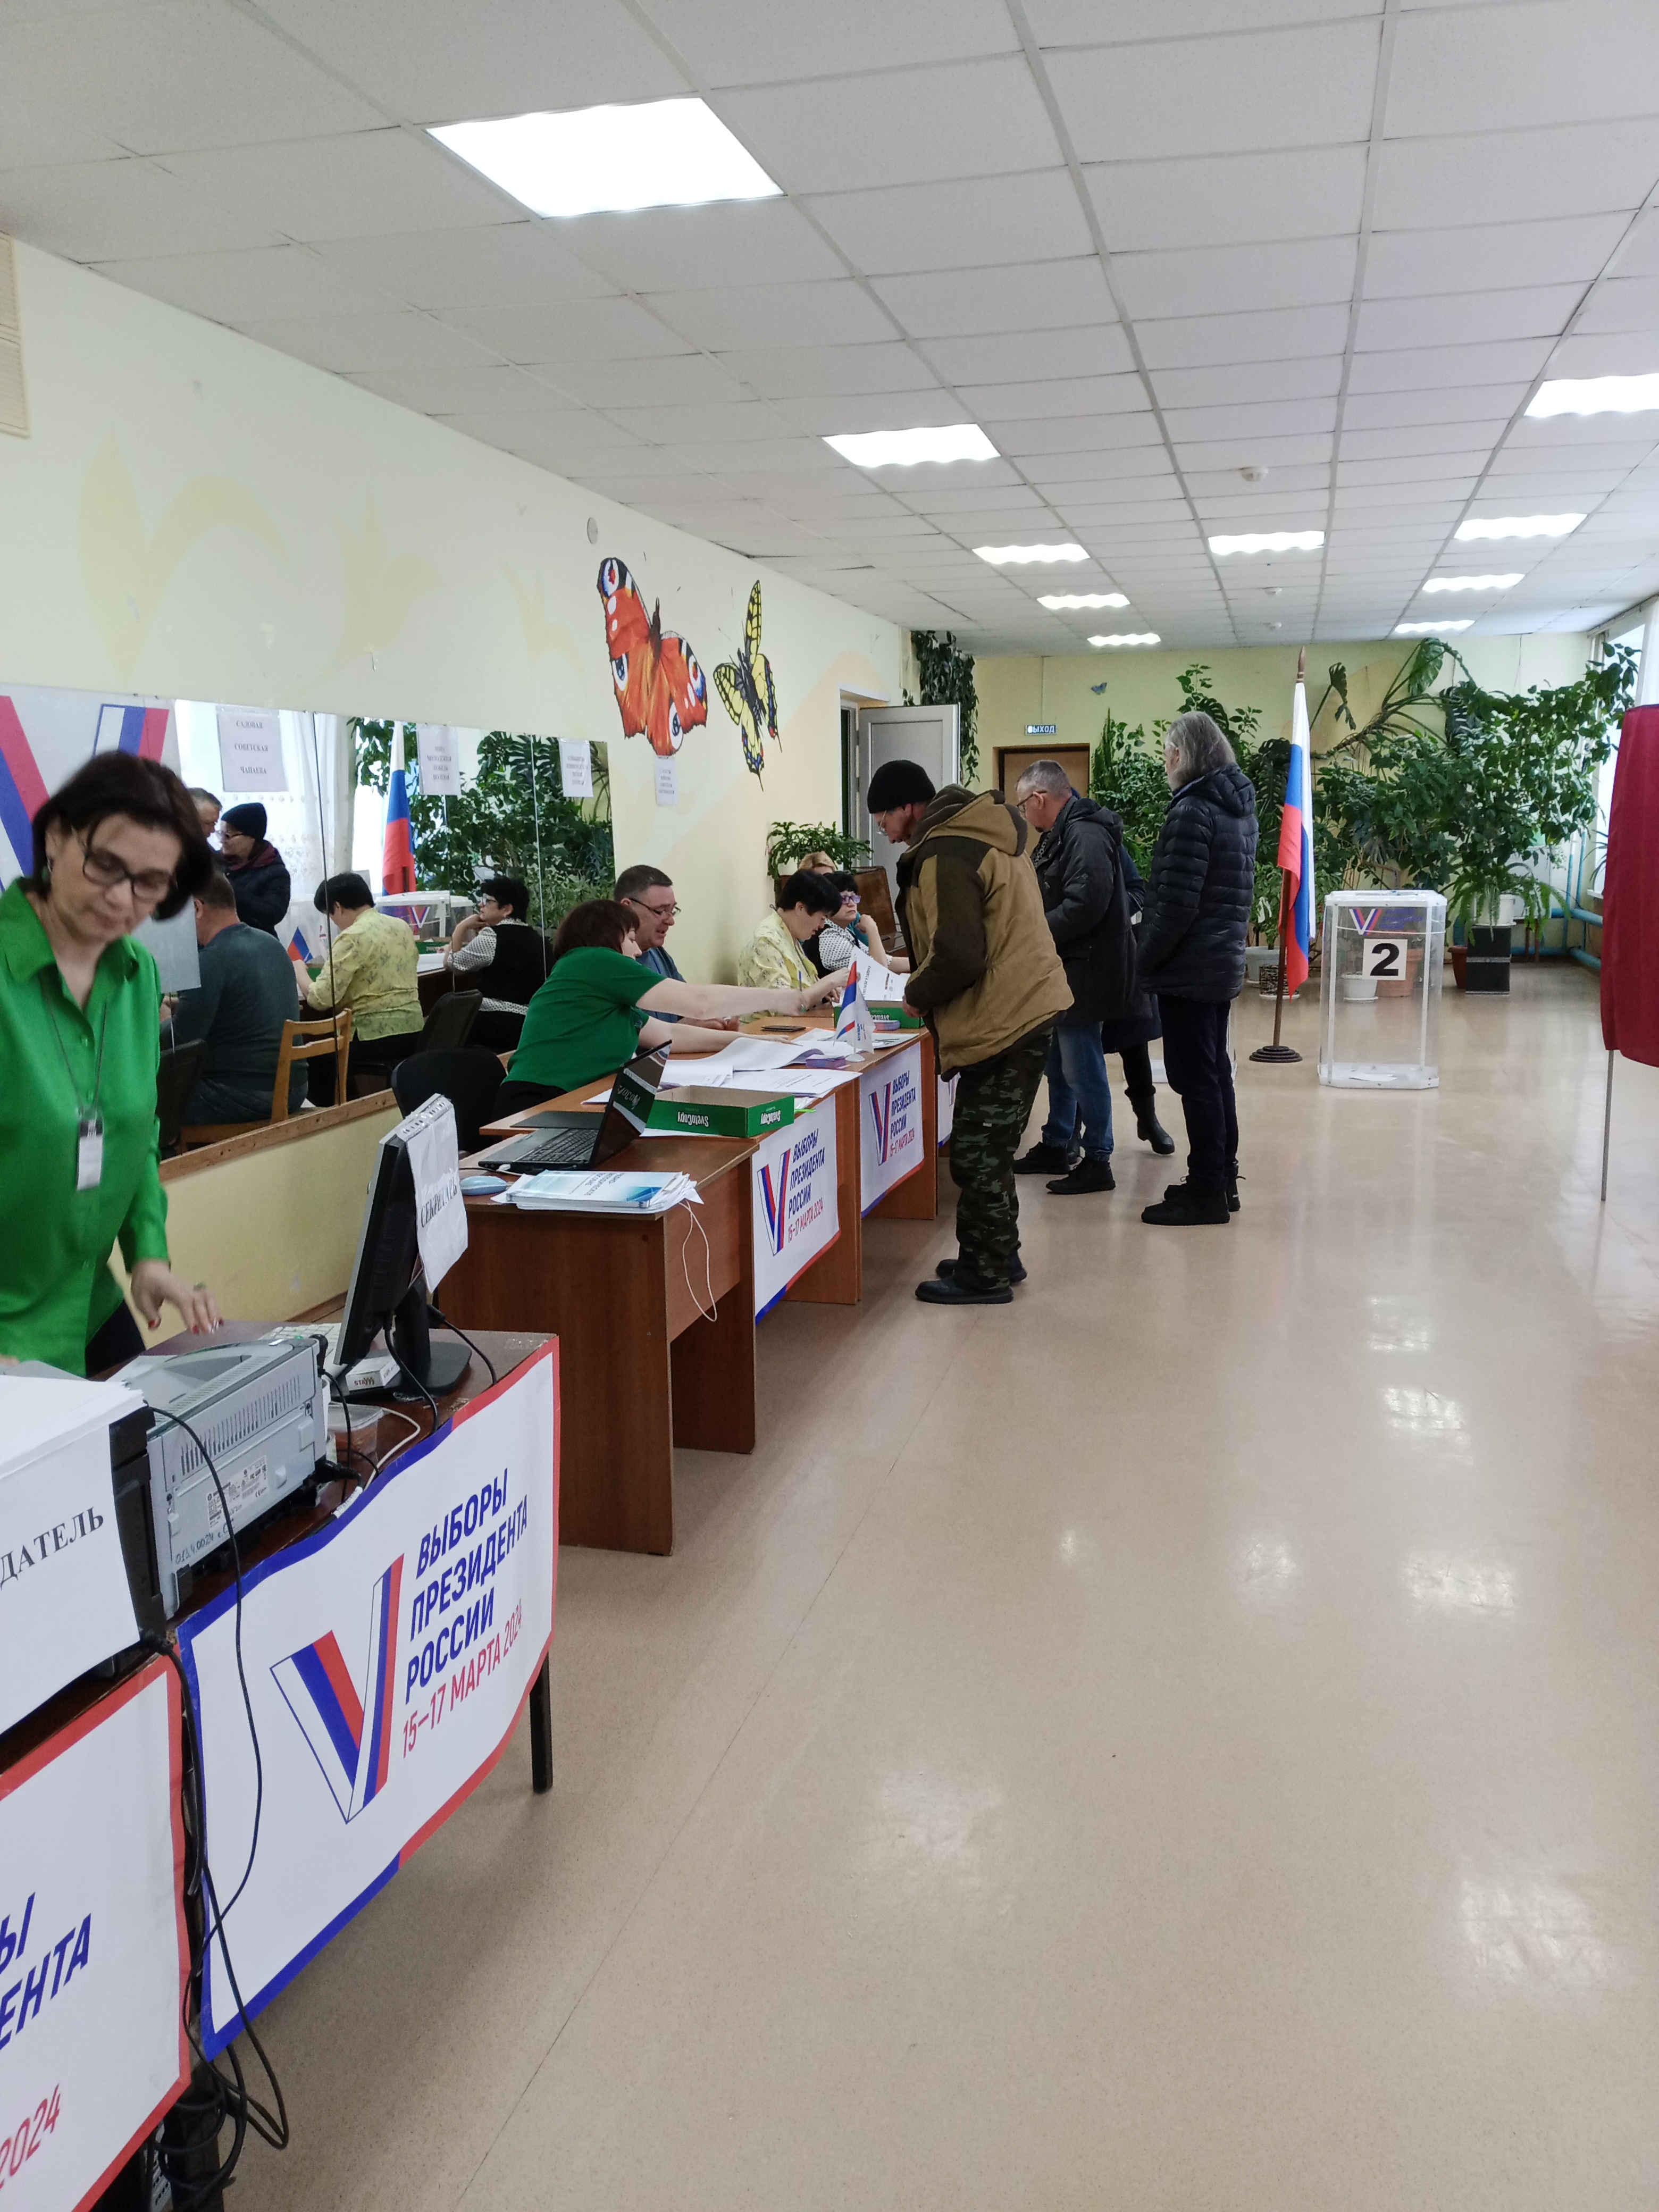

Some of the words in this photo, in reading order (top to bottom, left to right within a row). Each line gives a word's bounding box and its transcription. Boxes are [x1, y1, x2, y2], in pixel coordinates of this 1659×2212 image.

[1370, 943, 1400, 976] 2
[892, 1070, 910, 1095] ВЫБОРЫ
[677, 1111, 709, 1127] SvetoCopy
[760, 1110, 781, 1125] SvetoCopy
[891, 1087, 916, 1117] ПРЕЗИДЕНТА
[890, 1113, 907, 1139] РОССИИ
[792, 1128, 819, 1163] ВЫБОРЫ
[790, 1147, 825, 1191] ПРЕЗИДЕНТА
[789, 1182, 811, 1219] РОССИИ
[800, 1205, 813, 1232] МАРТА
[814, 1197, 824, 1219] 2024
[416, 1467, 508, 1580] ВЫБОРЫ
[0, 1506, 104, 1591] ДАТЕЛЬ
[410, 1494, 527, 1643] ПРЕЗИДЕНТА
[405, 1586, 495, 1705] РОССИИ
[450, 1632, 500, 1712] МАРТА
[503, 1598, 522, 1658] 2024
[0, 2082, 61, 2190] 2024
